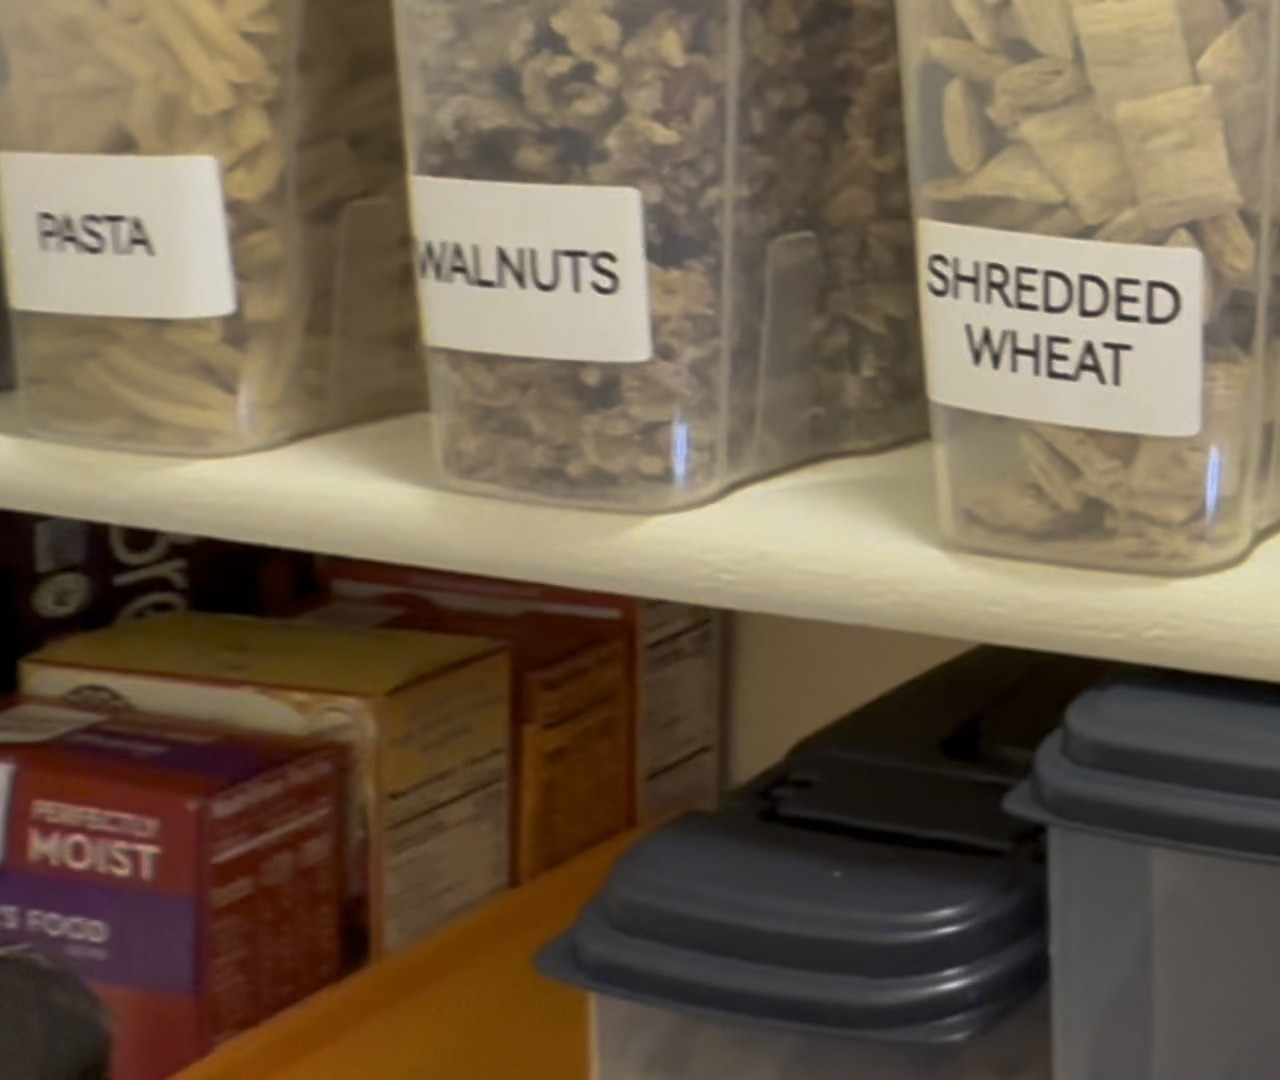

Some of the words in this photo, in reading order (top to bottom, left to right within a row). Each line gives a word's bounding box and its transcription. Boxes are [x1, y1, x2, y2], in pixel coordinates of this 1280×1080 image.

[38, 211, 156, 256] PASTA
[419, 239, 620, 296] WALNUTS
[927, 253, 1181, 325] SHREDDED
[964, 322, 1133, 387] WHEAT
[27, 827, 162, 881] MOIST
[26, 908, 111, 944] FOOD
